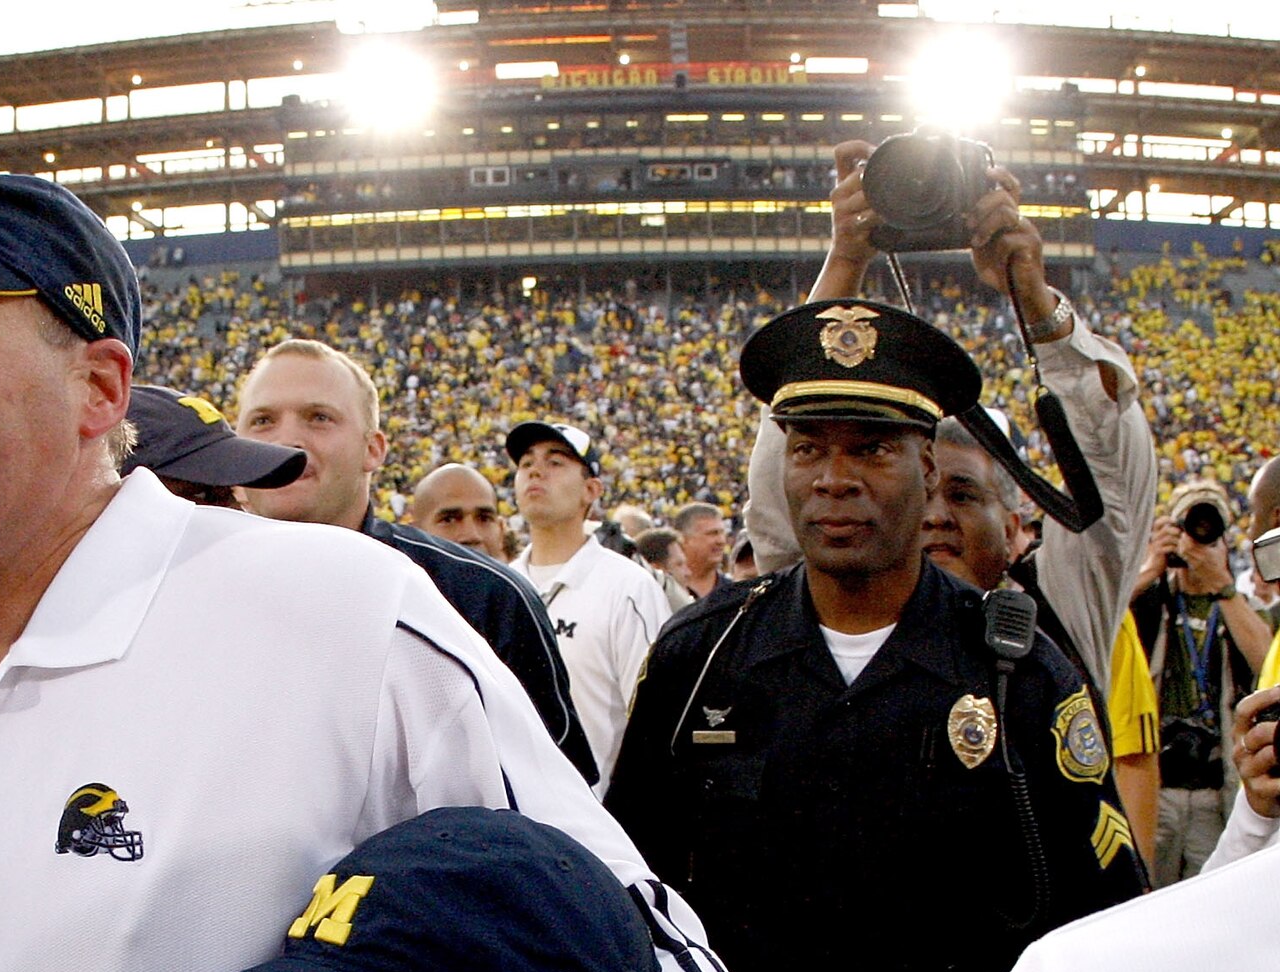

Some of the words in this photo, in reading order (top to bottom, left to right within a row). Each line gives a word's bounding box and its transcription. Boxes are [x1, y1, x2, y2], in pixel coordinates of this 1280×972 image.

[707, 66, 809, 85] STADIUM
[64, 286, 106, 333] adidas
[555, 618, 577, 638] M
[288, 874, 375, 946] M
